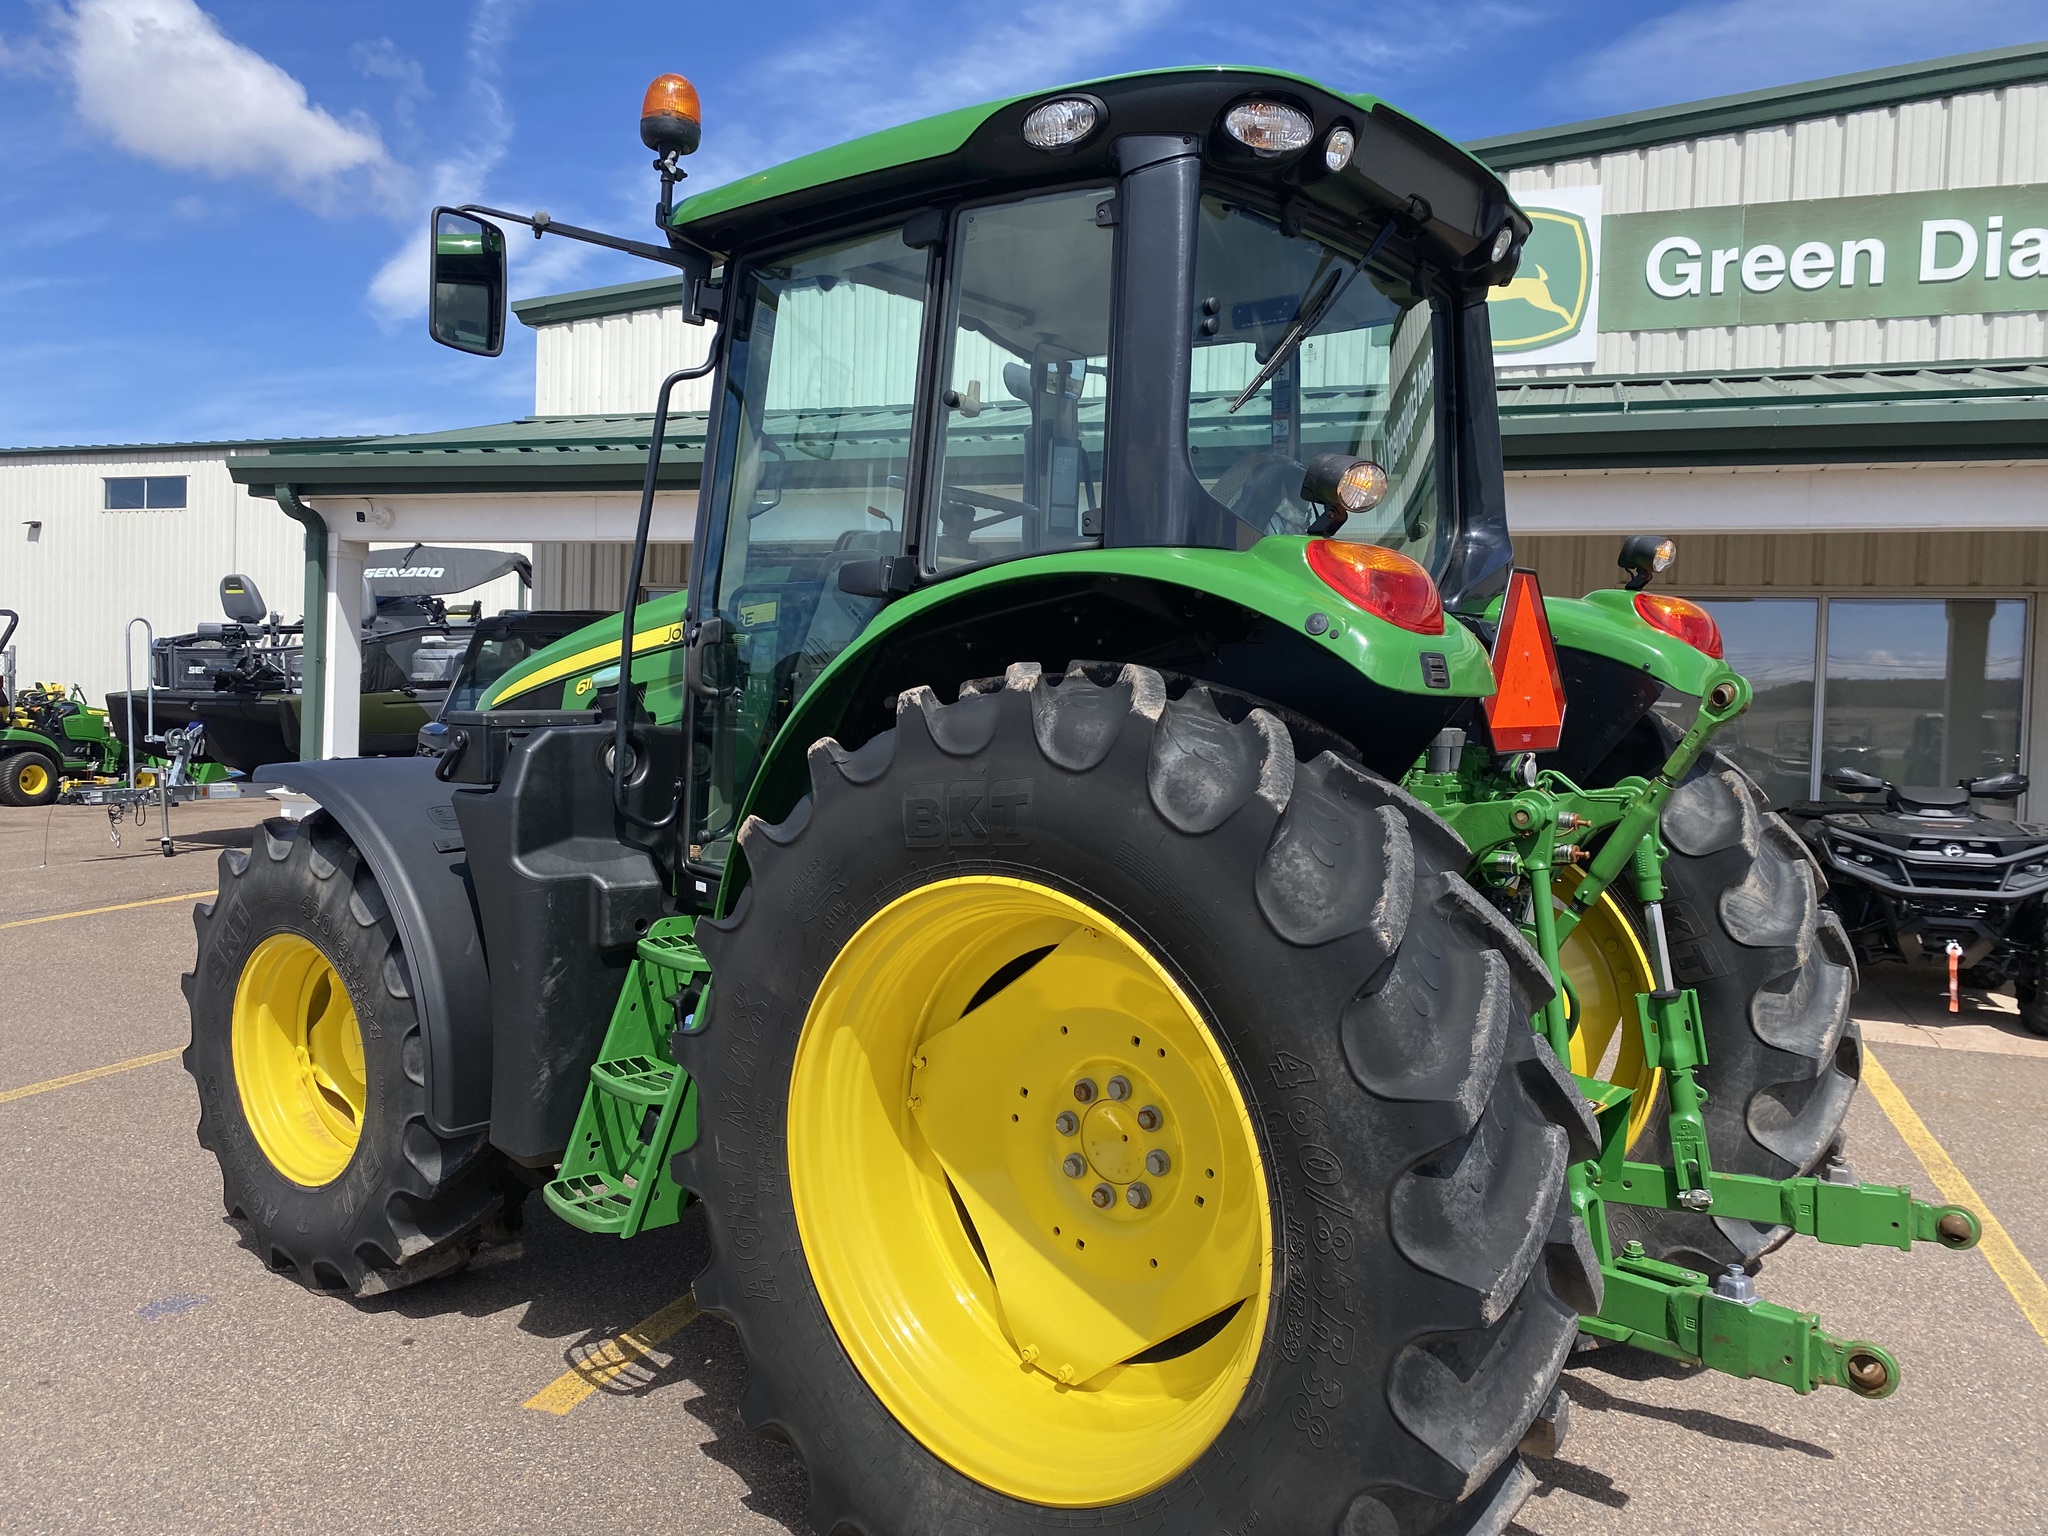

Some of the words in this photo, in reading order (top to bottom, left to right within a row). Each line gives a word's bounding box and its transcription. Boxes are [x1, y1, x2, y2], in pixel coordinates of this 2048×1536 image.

[1645, 235, 1886, 298] Green
[904, 789, 1031, 841] BKT
[207, 897, 249, 985] BKT
[717, 981, 769, 1134] MAX
[717, 1136, 782, 1303] AGRI
